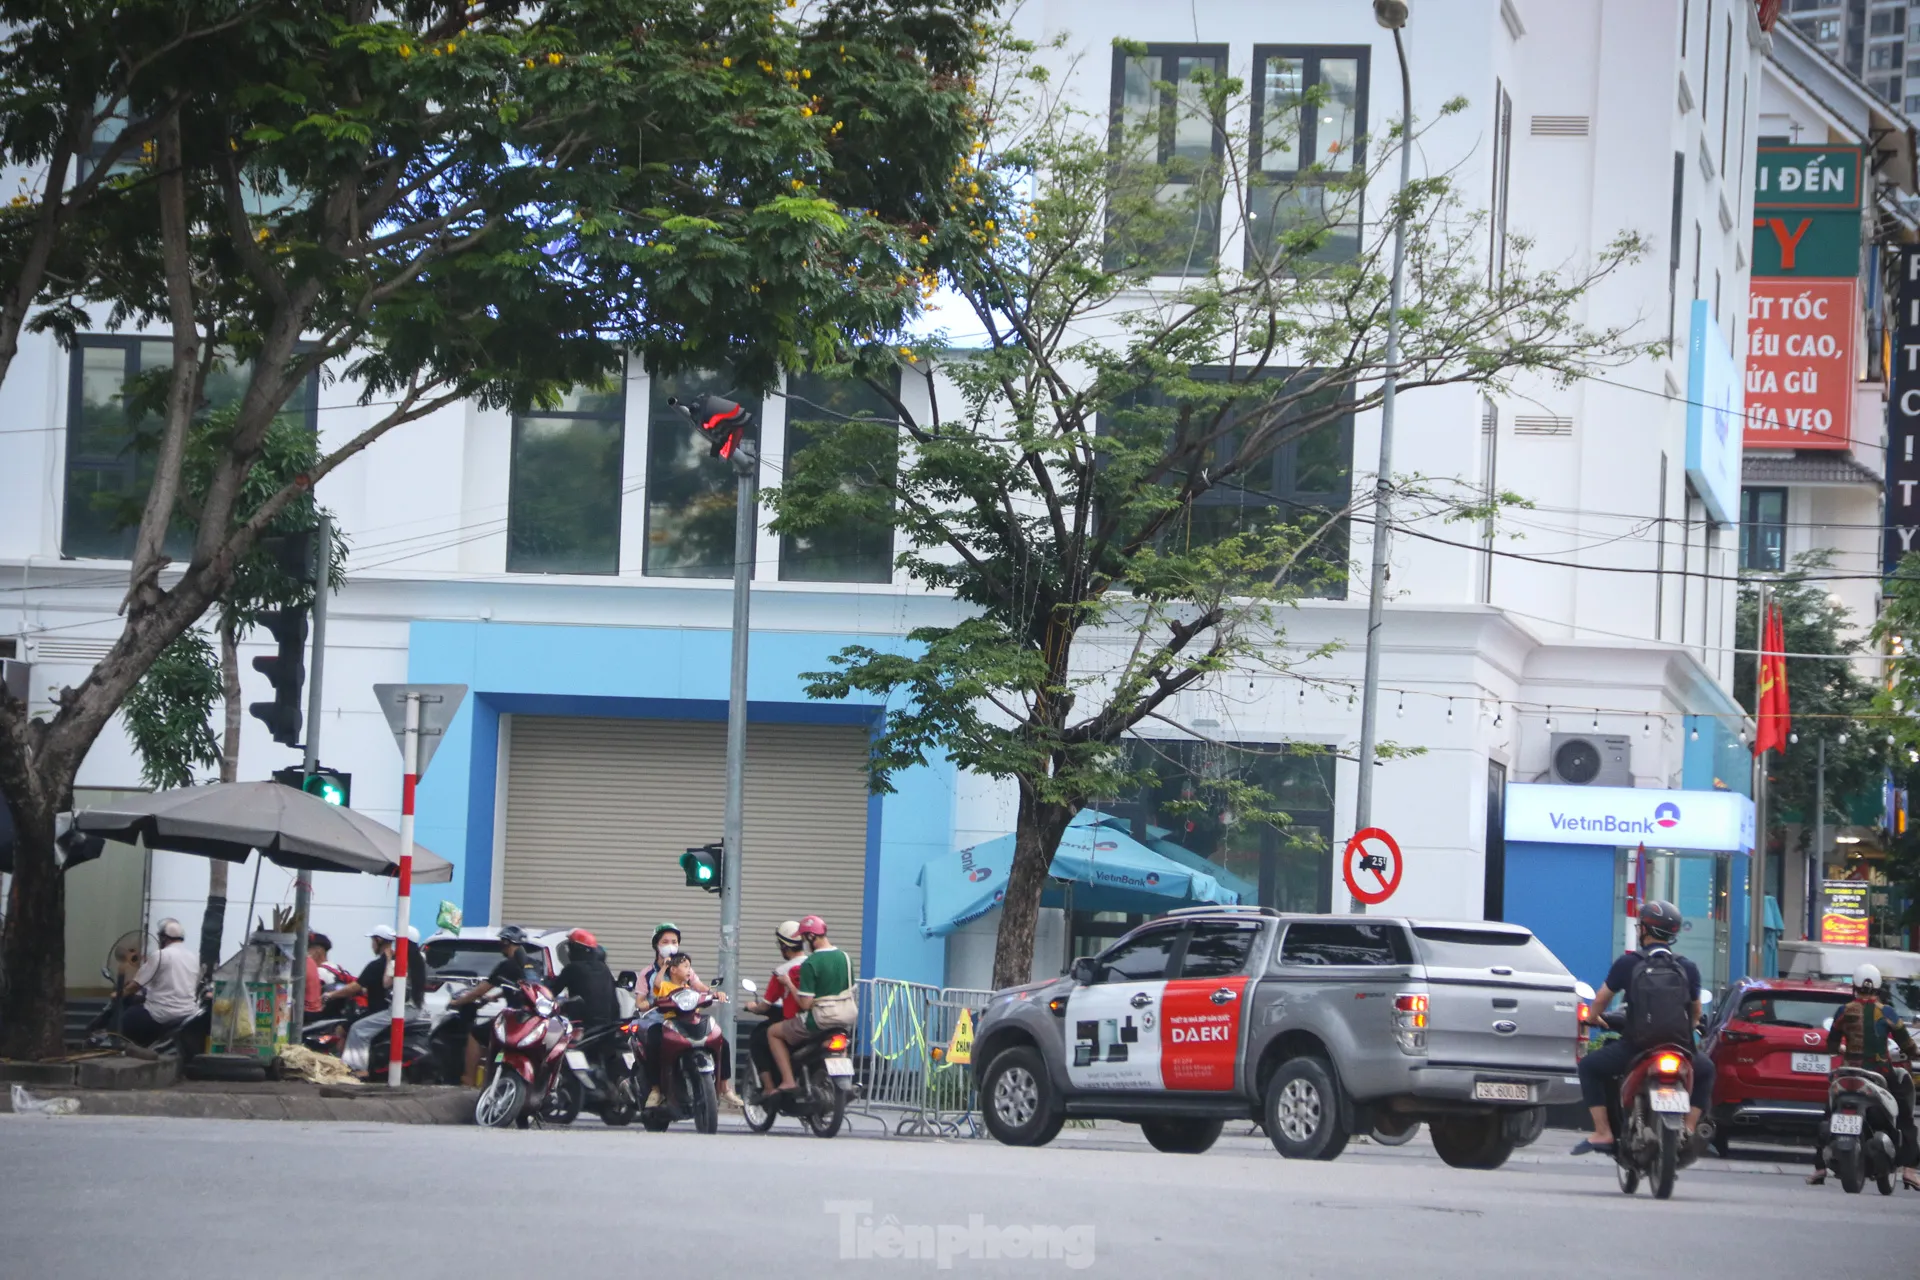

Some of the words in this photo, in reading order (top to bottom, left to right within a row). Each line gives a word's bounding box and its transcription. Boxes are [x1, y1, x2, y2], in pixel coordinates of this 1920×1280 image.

[1778, 154, 1845, 191] ĐẾN
[1779, 290, 1829, 320] TỐC
[1785, 334, 1843, 359] CAO,
[1783, 366, 1818, 393] GÙ
[1785, 407, 1833, 435] VẸO
[1549, 812, 1655, 834] VietinBank
[1171, 1026, 1229, 1043] DAEKI
